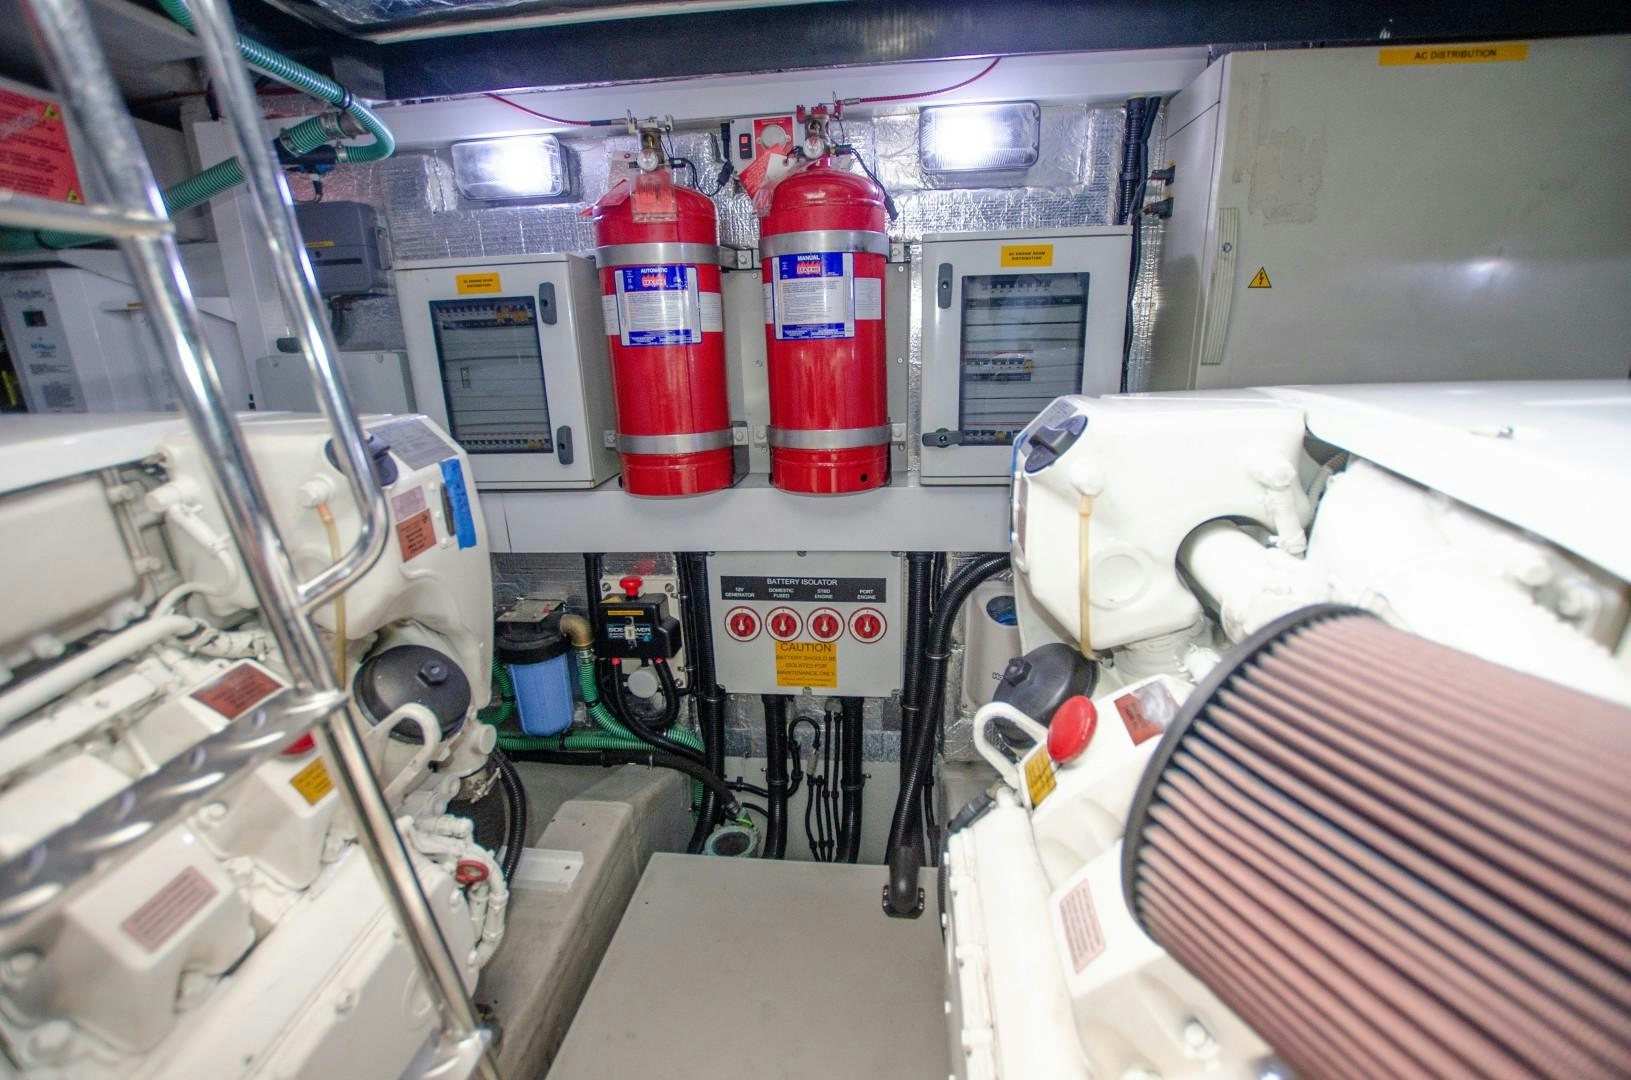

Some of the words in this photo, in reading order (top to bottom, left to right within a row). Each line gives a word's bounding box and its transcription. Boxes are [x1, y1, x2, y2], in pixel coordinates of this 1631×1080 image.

[1414, 51, 1429, 60] AC
[1430, 49, 1497, 59] DISTRIBUTION
[780, 642, 832, 652] CAUTION
